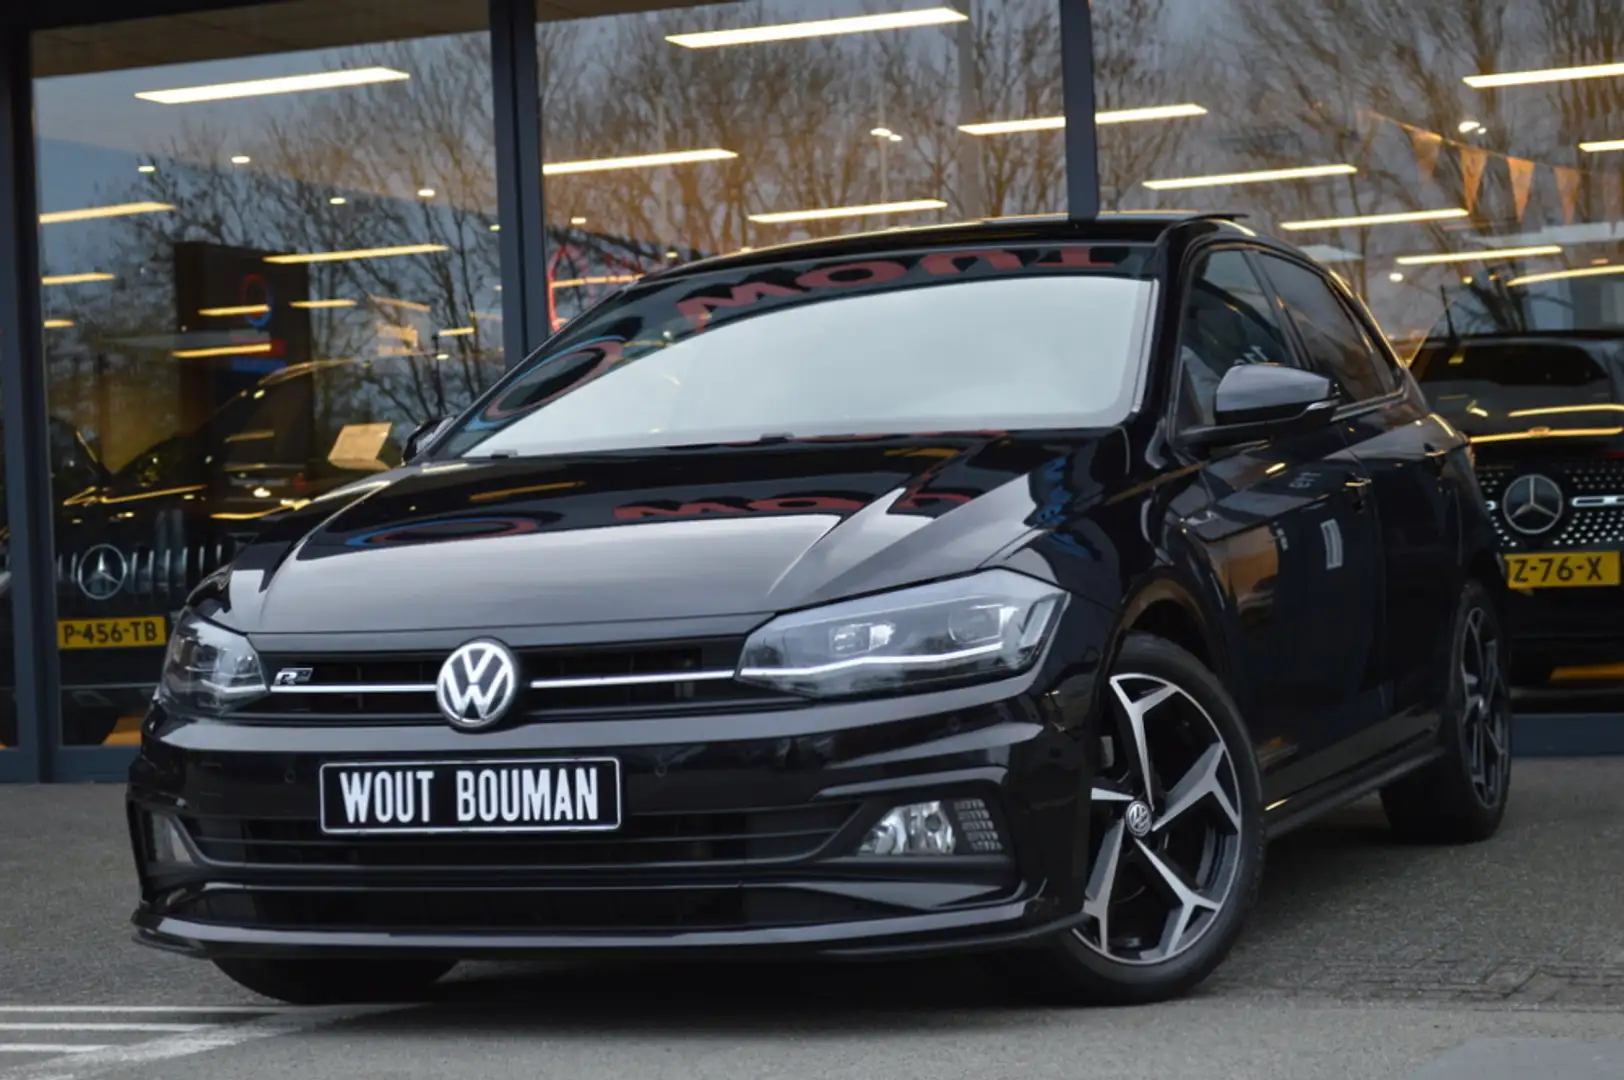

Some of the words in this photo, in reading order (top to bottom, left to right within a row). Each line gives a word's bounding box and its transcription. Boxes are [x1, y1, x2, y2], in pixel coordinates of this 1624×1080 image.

[63, 620, 157, 645] P-456-TB
[339, 770, 434, 824] WOUT
[455, 766, 598, 822] BOUMAN
